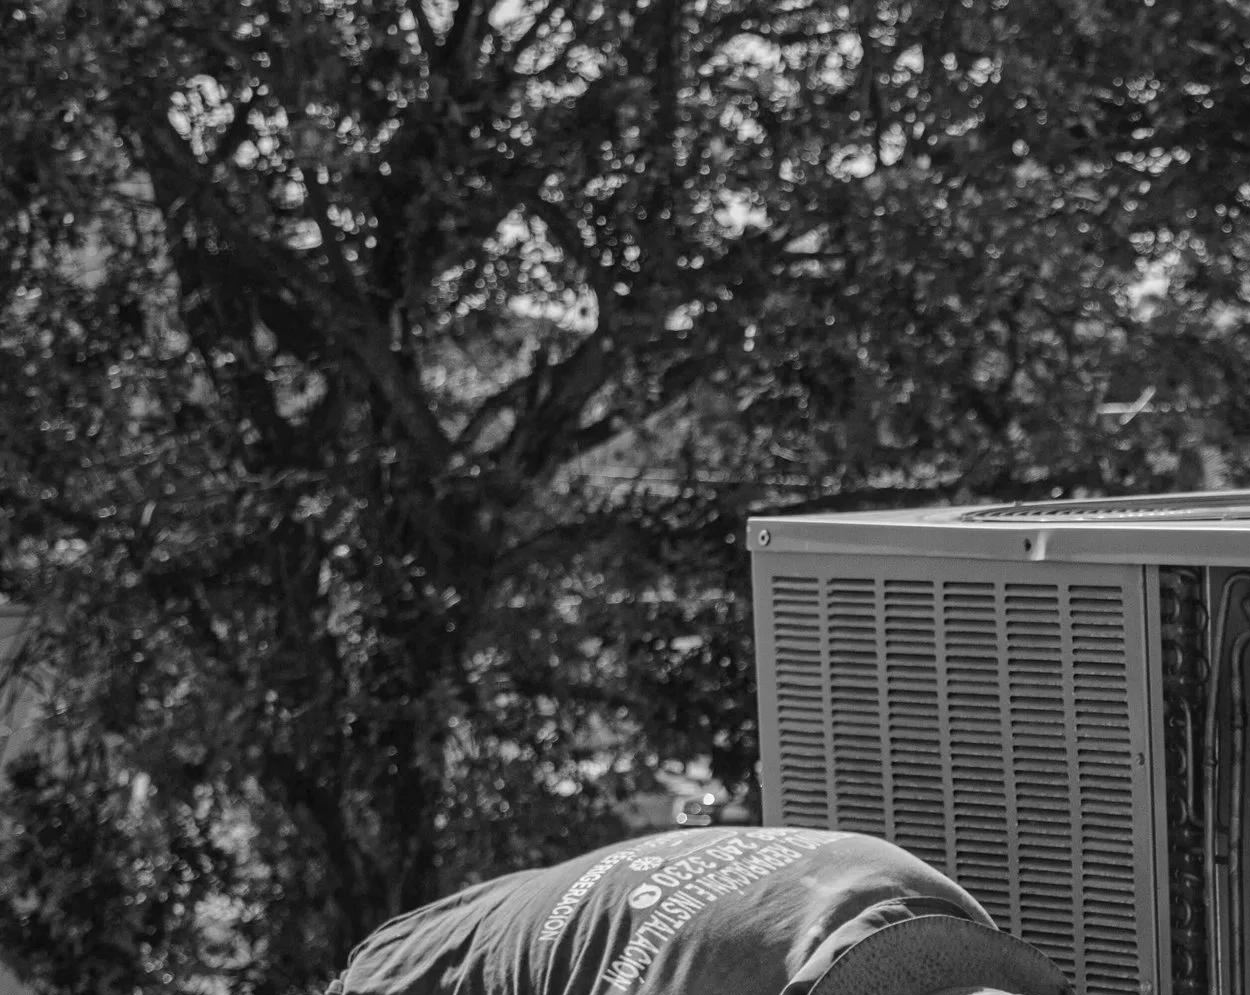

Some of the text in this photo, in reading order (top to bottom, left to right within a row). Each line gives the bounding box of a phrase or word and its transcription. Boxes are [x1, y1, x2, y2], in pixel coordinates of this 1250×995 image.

[705, 837, 757, 862] 240
[651, 855, 717, 888] 3230
[602, 847, 803, 992] REPARACIÓN E INSTALACIÓN
